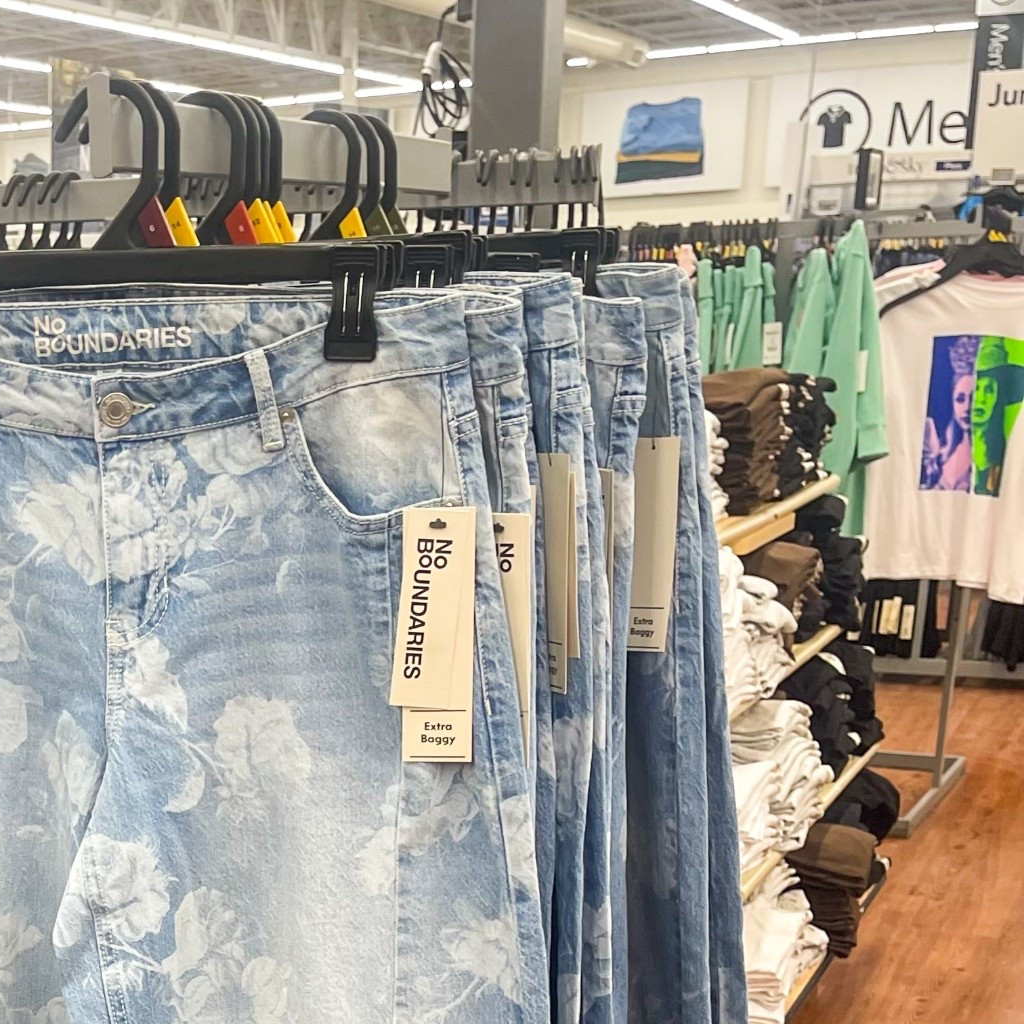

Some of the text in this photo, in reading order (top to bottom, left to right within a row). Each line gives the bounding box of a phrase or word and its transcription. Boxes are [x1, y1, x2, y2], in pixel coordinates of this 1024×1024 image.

[888, 100, 968, 146] Me
[403, 538, 435, 679] BOUNDARIES
[633, 616, 654, 625] Extra
[629, 627, 655, 638] Baggy
[424, 721, 453, 731] Extra
[420, 734, 456, 746] Baggy
